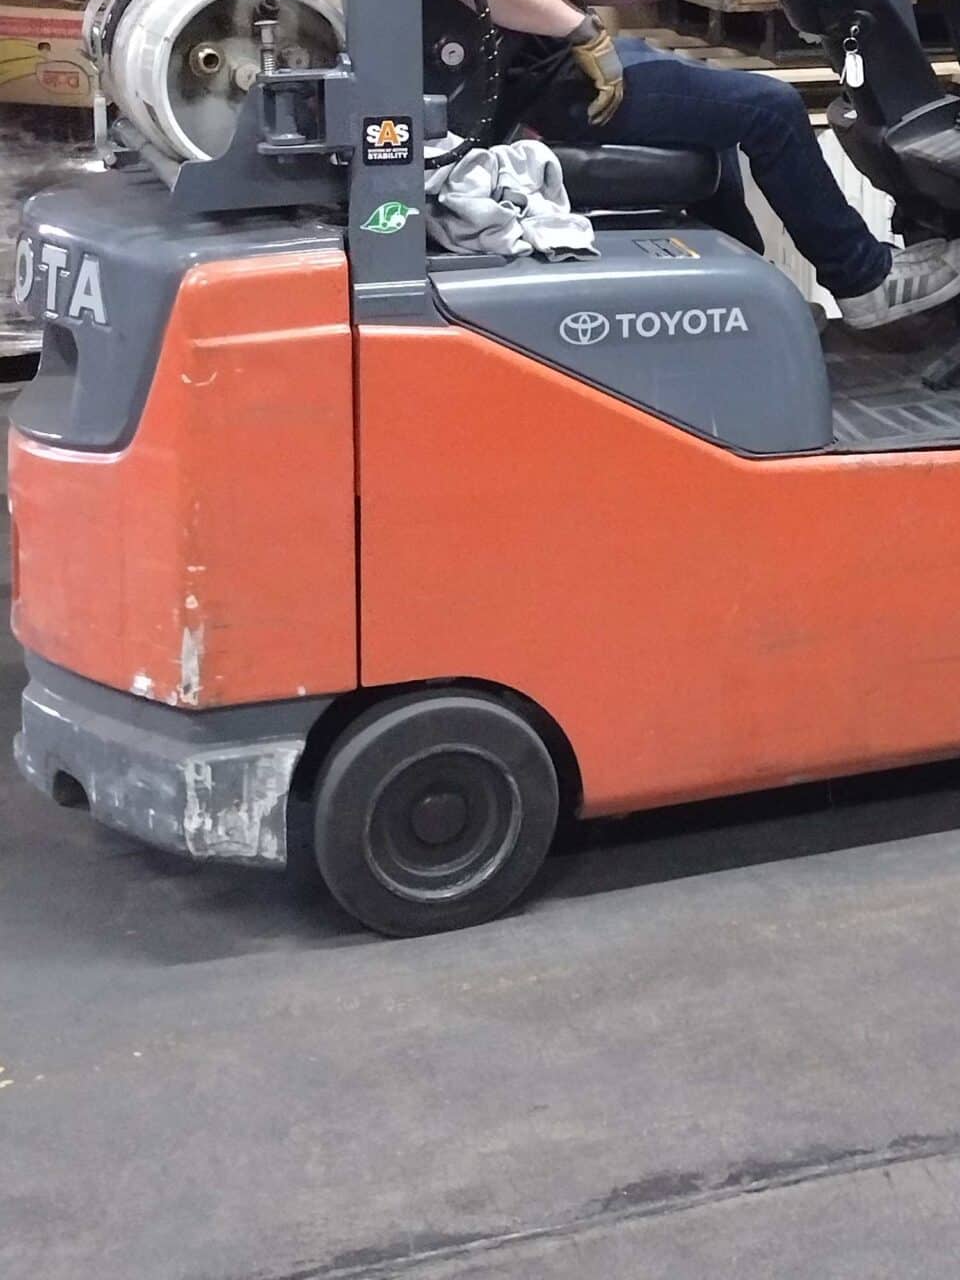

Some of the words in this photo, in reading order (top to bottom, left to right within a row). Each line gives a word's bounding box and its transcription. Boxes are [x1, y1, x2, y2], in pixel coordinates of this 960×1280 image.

[366, 120, 409, 147] SAS
[367, 151, 409, 160] STABILITY
[615, 307, 749, 339] TOYOTA
